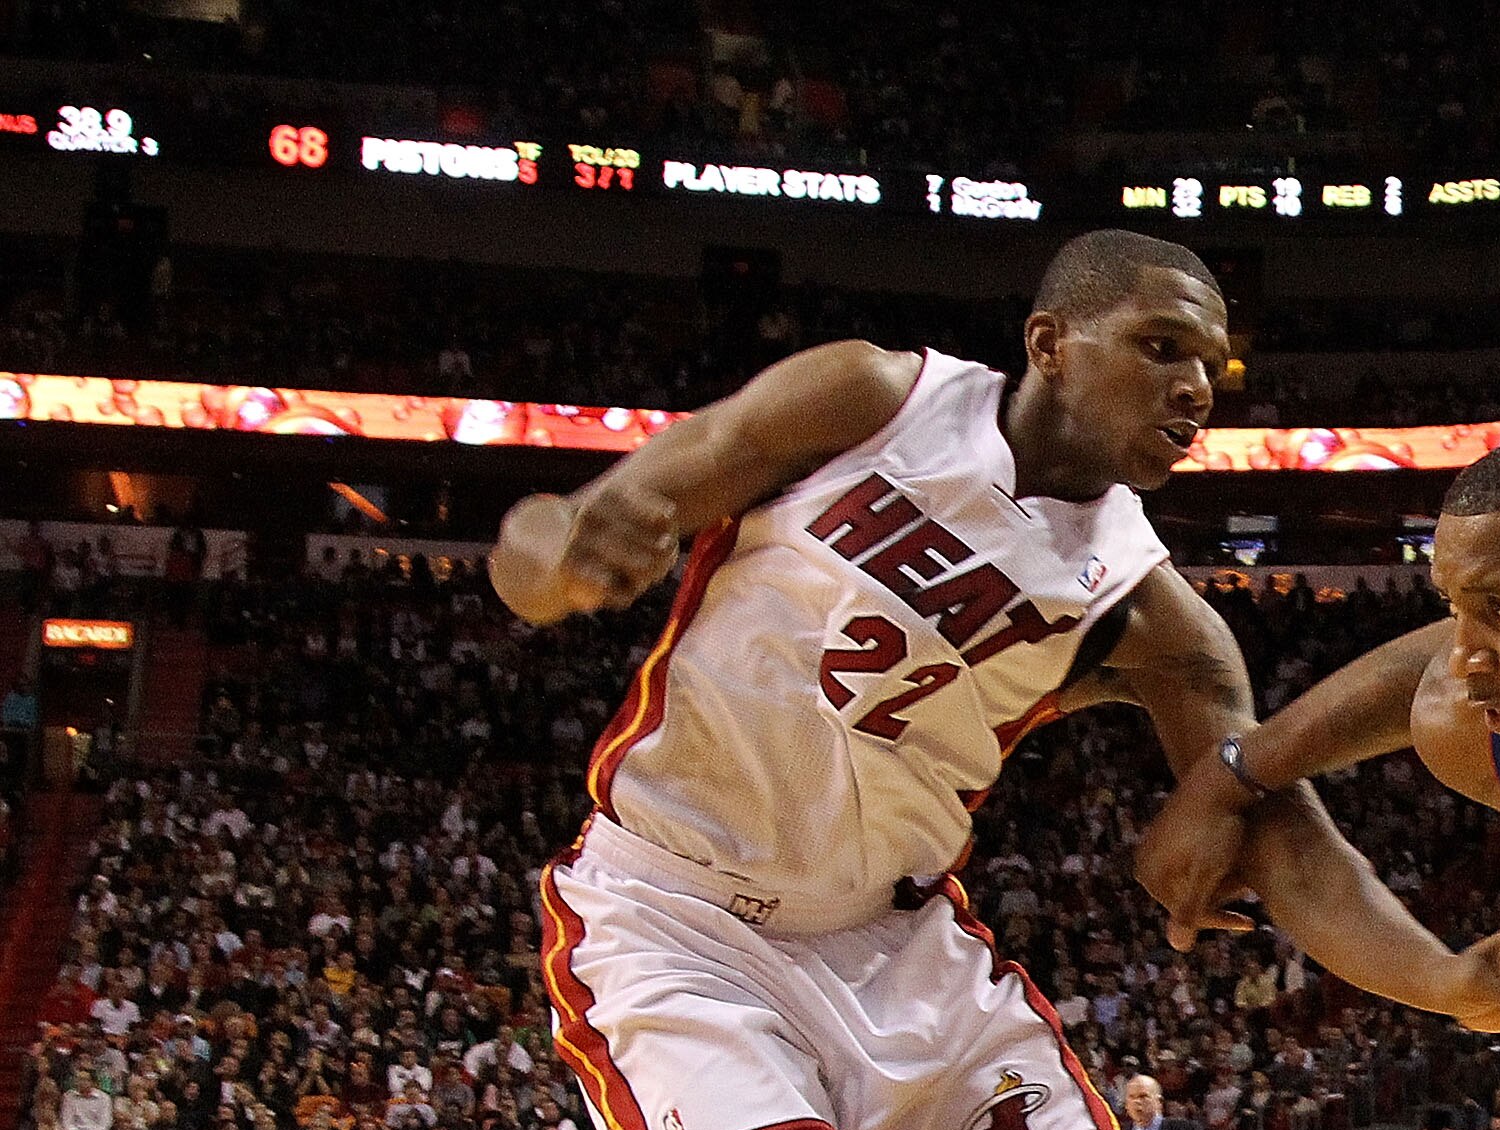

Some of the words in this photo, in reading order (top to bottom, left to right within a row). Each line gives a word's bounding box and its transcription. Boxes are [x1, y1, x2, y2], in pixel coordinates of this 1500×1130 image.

[142, 137, 158, 155] 3
[270, 124, 328, 167] 68
[362, 137, 518, 180] PISTONS
[518, 159, 537, 184] 5
[664, 161, 780, 196] PLAYER
[782, 170, 880, 203] STATS
[1123, 187, 1165, 207] MIN
[1220, 186, 1266, 207] PTS
[1322, 185, 1371, 206] REB
[1429, 178, 1500, 203] ASSTS
[804, 471, 1083, 667] HEAT
[818, 614, 960, 743] 22
